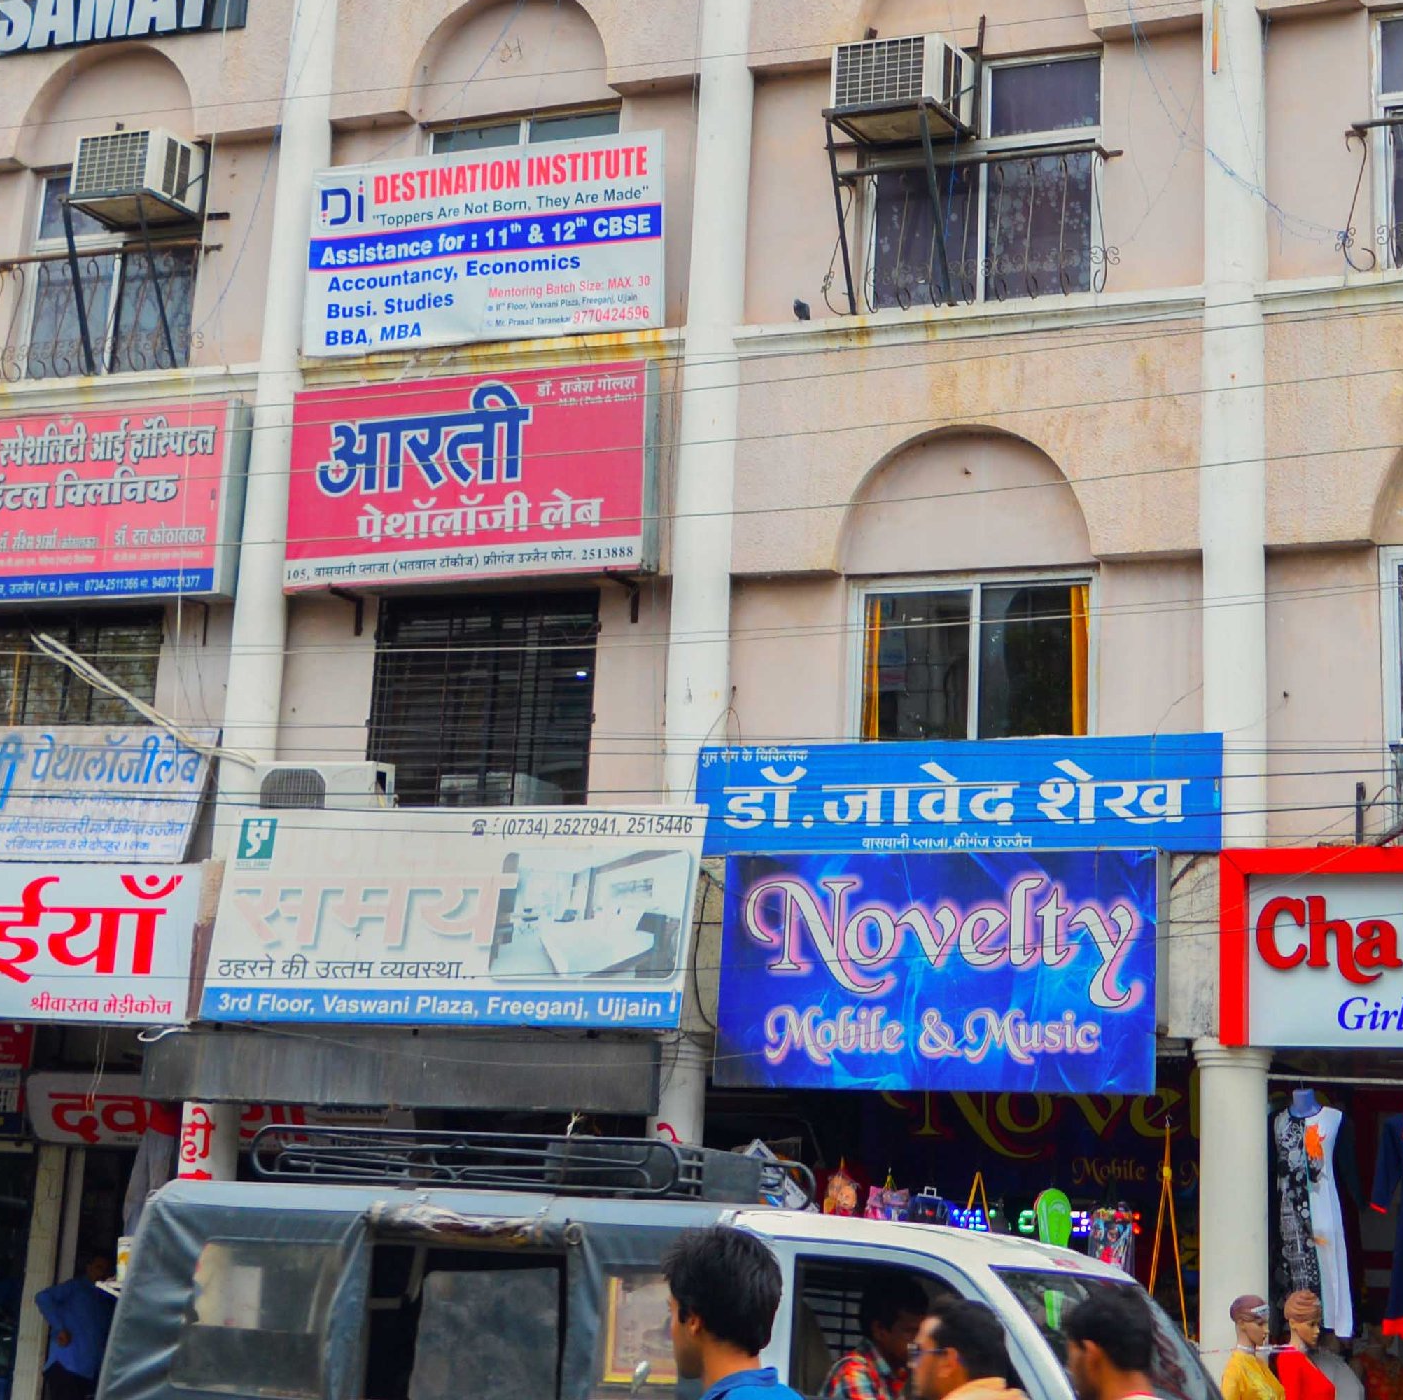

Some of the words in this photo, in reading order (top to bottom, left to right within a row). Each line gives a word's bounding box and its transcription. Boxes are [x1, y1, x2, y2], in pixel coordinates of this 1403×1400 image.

[373, 159, 521, 206] DESTINATION
[527, 146, 648, 188] INSTITUTE
[437, 205, 460, 218] Are
[464, 202, 489, 216] Not
[492, 199, 532, 214] Born,
[536, 195, 570, 211] They
[574, 192, 599, 204] Are
[603, 185, 649, 202] Made"
[320, 238, 433, 267] Assistance
[437, 232, 466, 253] for
[485, 222, 522, 247] 11th
[527, 226, 545, 245] &
[551, 216, 588, 242] 12th
[592, 213, 652, 238] CBSE
[327, 266, 459, 294] Accountancy,
[466, 254, 582, 278] Economics
[488, 285, 543, 300] Mentoring
[546, 281, 576, 296] Batch
[327, 301, 378, 320] Busi.
[383, 292, 455, 316] Studies
[325, 327, 373, 347] BBA,
[380, 322, 422, 342] MBA
[90, 416, 130, 465] आई
[315, 379, 534, 498] आरती
[54, 464, 181, 509] क्लिनिक
[539, 488, 605, 532] लेब
[742, 747, 754, 763] के
[722, 766, 814, 831] डॉ.
[821, 761, 1021, 828] जावेद
[1036, 757, 1192, 826] शेख
[501, 816, 549, 839] (0734)
[626, 815, 694, 836] 2515446
[231, 871, 520, 953] समय
[745, 876, 1135, 1009] Novelty
[217, 952, 274, 980] ठहरने
[281, 953, 307, 980] की
[315, 957, 372, 980] उत्तम
[30, 992, 100, 1014] श्रीवास्तव
[217, 993, 252, 1013] 3rd
[257, 992, 315, 1017] Floor,
[321, 994, 411, 1016] Vaswani
[414, 996, 480, 1019] Plaza,
[486, 996, 590, 1020] Freeganj,
[596, 998, 663, 1022] Ujjain
[764, 1006, 904, 1064] Mobile
[917, 1008, 957, 1057] &
[962, 1007, 1100, 1064] Music
